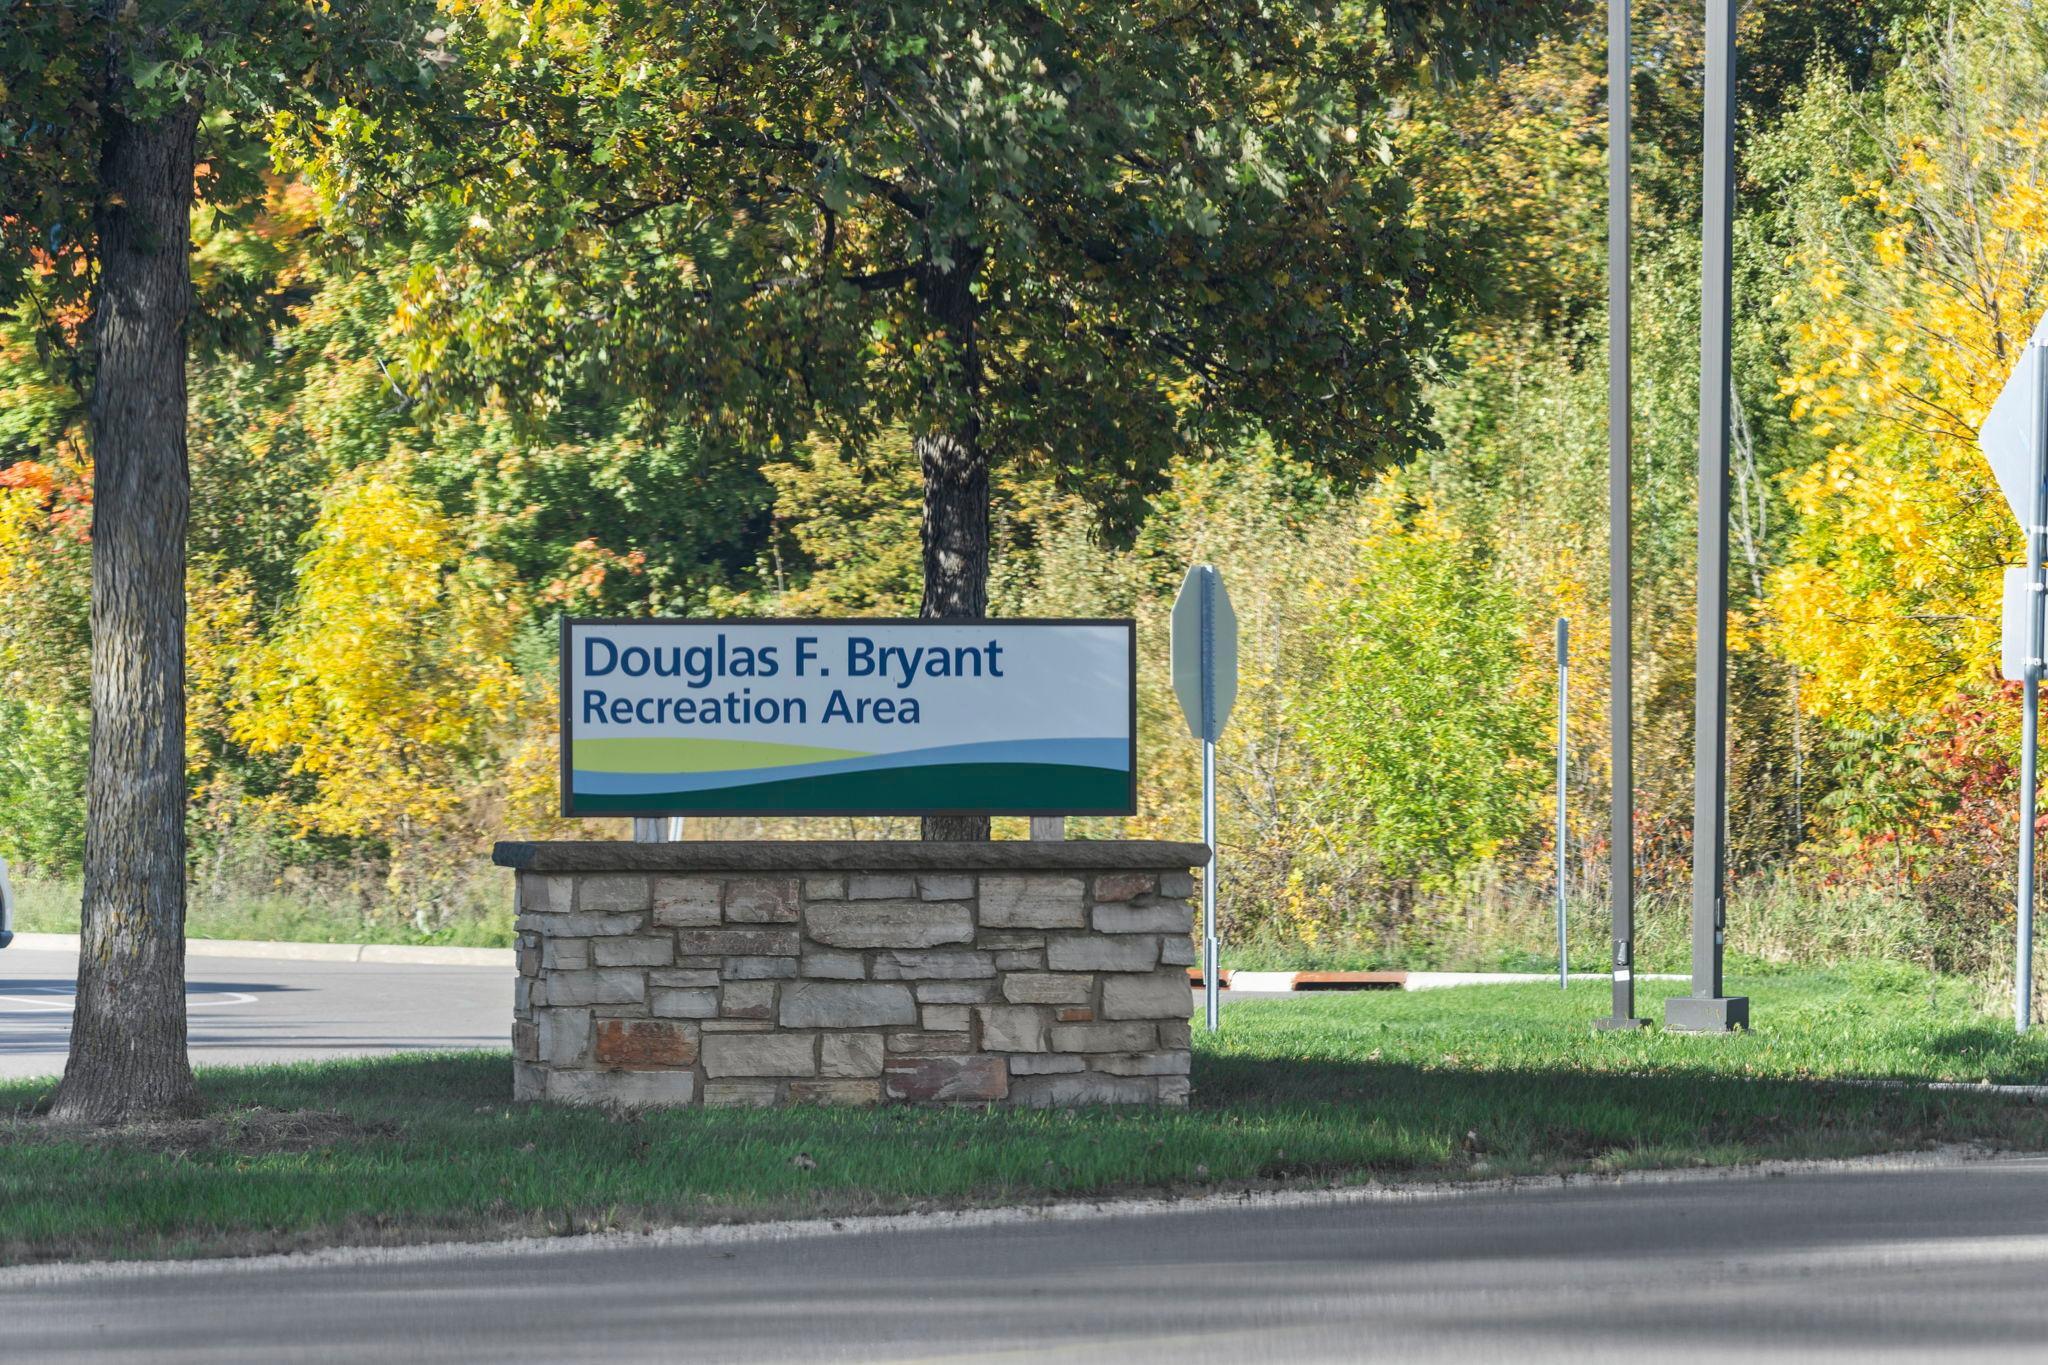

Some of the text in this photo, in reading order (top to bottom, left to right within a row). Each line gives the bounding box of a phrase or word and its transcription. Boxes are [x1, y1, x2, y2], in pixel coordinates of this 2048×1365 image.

[584, 633, 1004, 689] Douglas F. Bryant
[583, 688, 920, 725] Recreation Area
